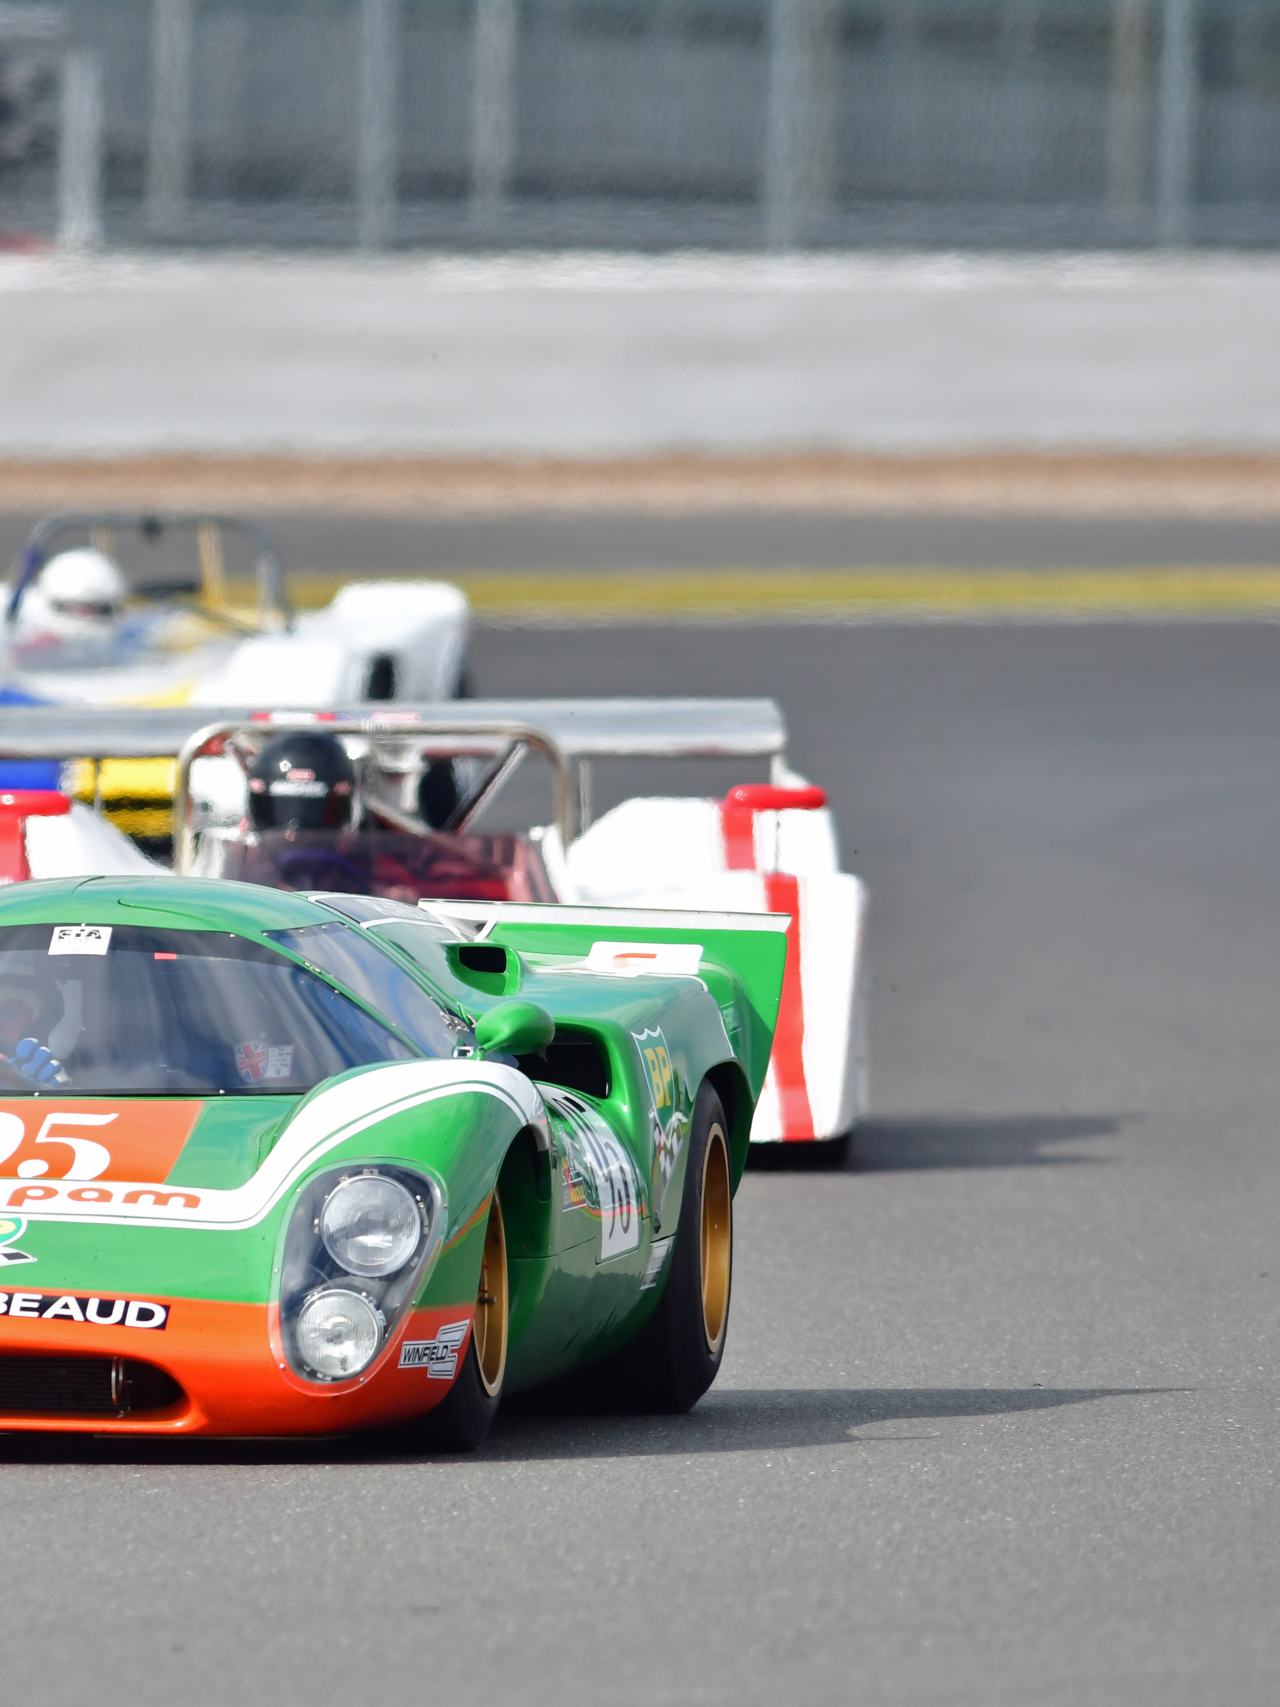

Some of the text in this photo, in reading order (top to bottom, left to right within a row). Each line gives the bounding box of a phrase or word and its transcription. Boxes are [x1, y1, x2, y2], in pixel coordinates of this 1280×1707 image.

[643, 1046, 671, 1109] BP
[6, 1184, 202, 1209] pam
[404, 1345, 449, 1363] WINFIELD
